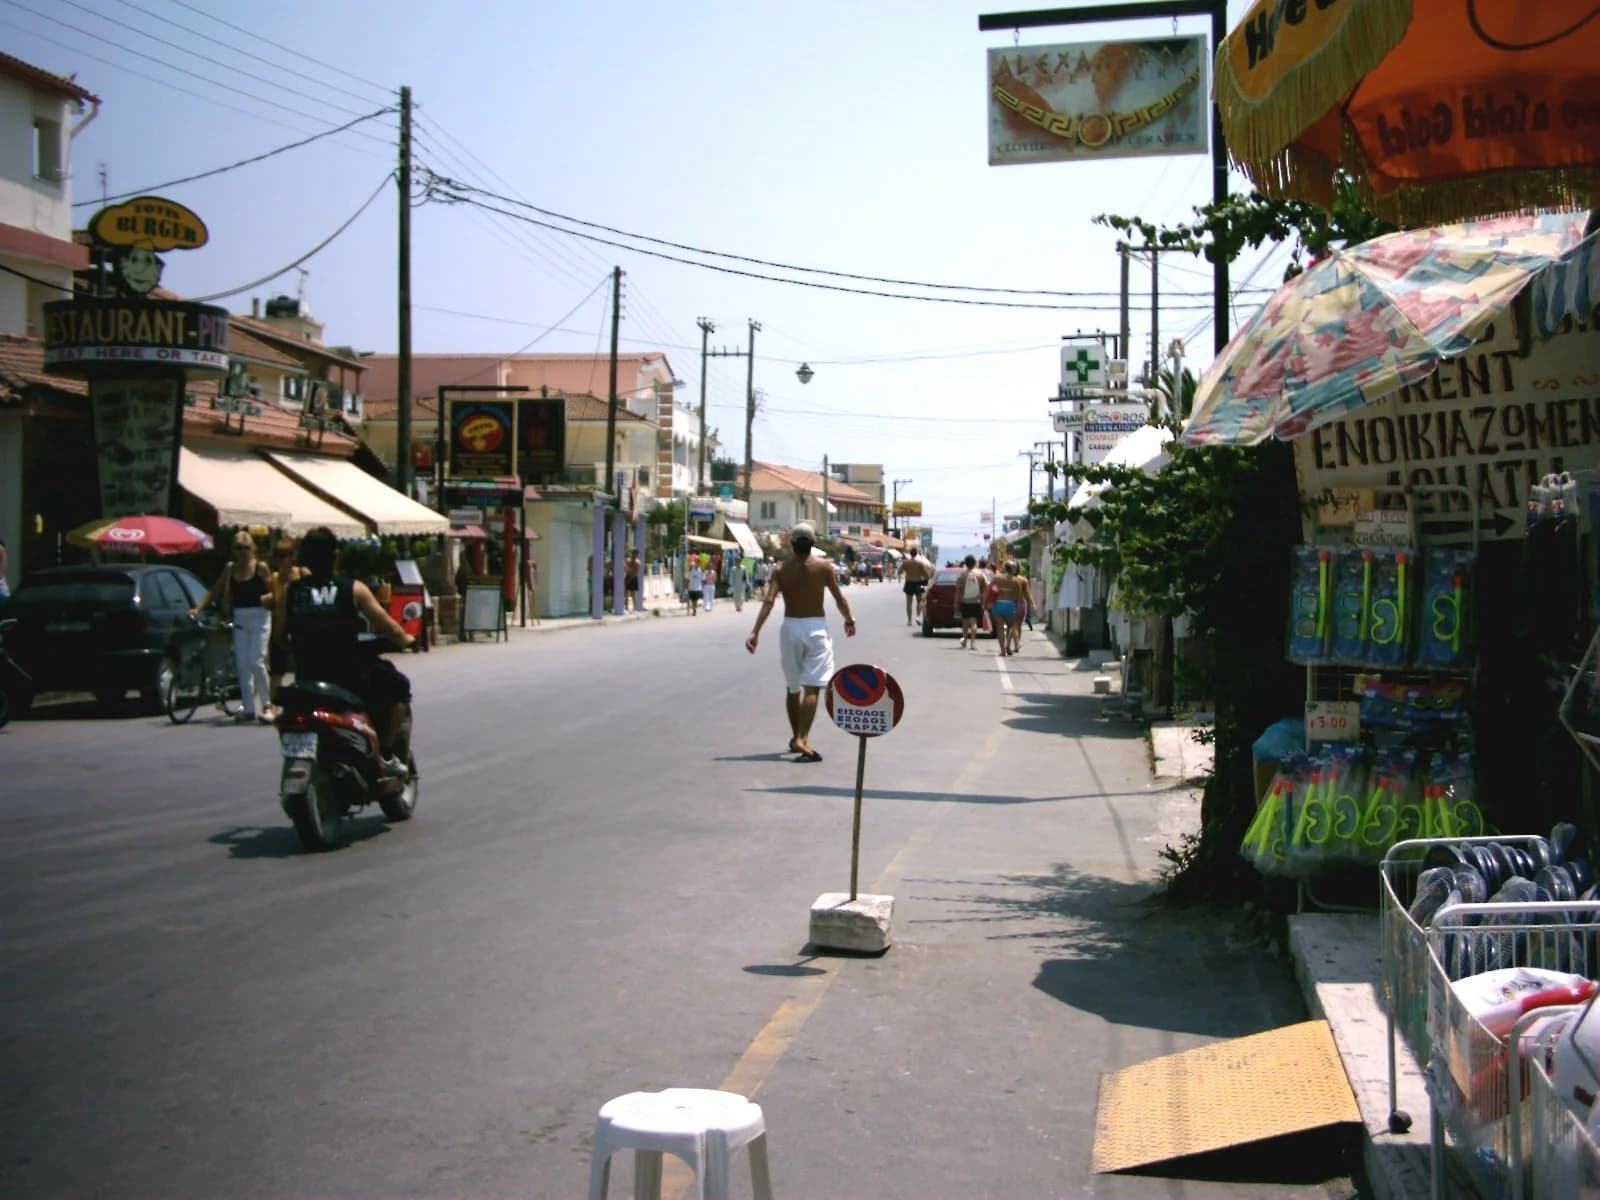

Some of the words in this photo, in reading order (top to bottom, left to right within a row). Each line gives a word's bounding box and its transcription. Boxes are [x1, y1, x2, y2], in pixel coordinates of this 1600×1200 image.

[116, 216, 197, 242] BURGER
[96, 348, 145, 360] HERE
[156, 350, 181, 361] OR
